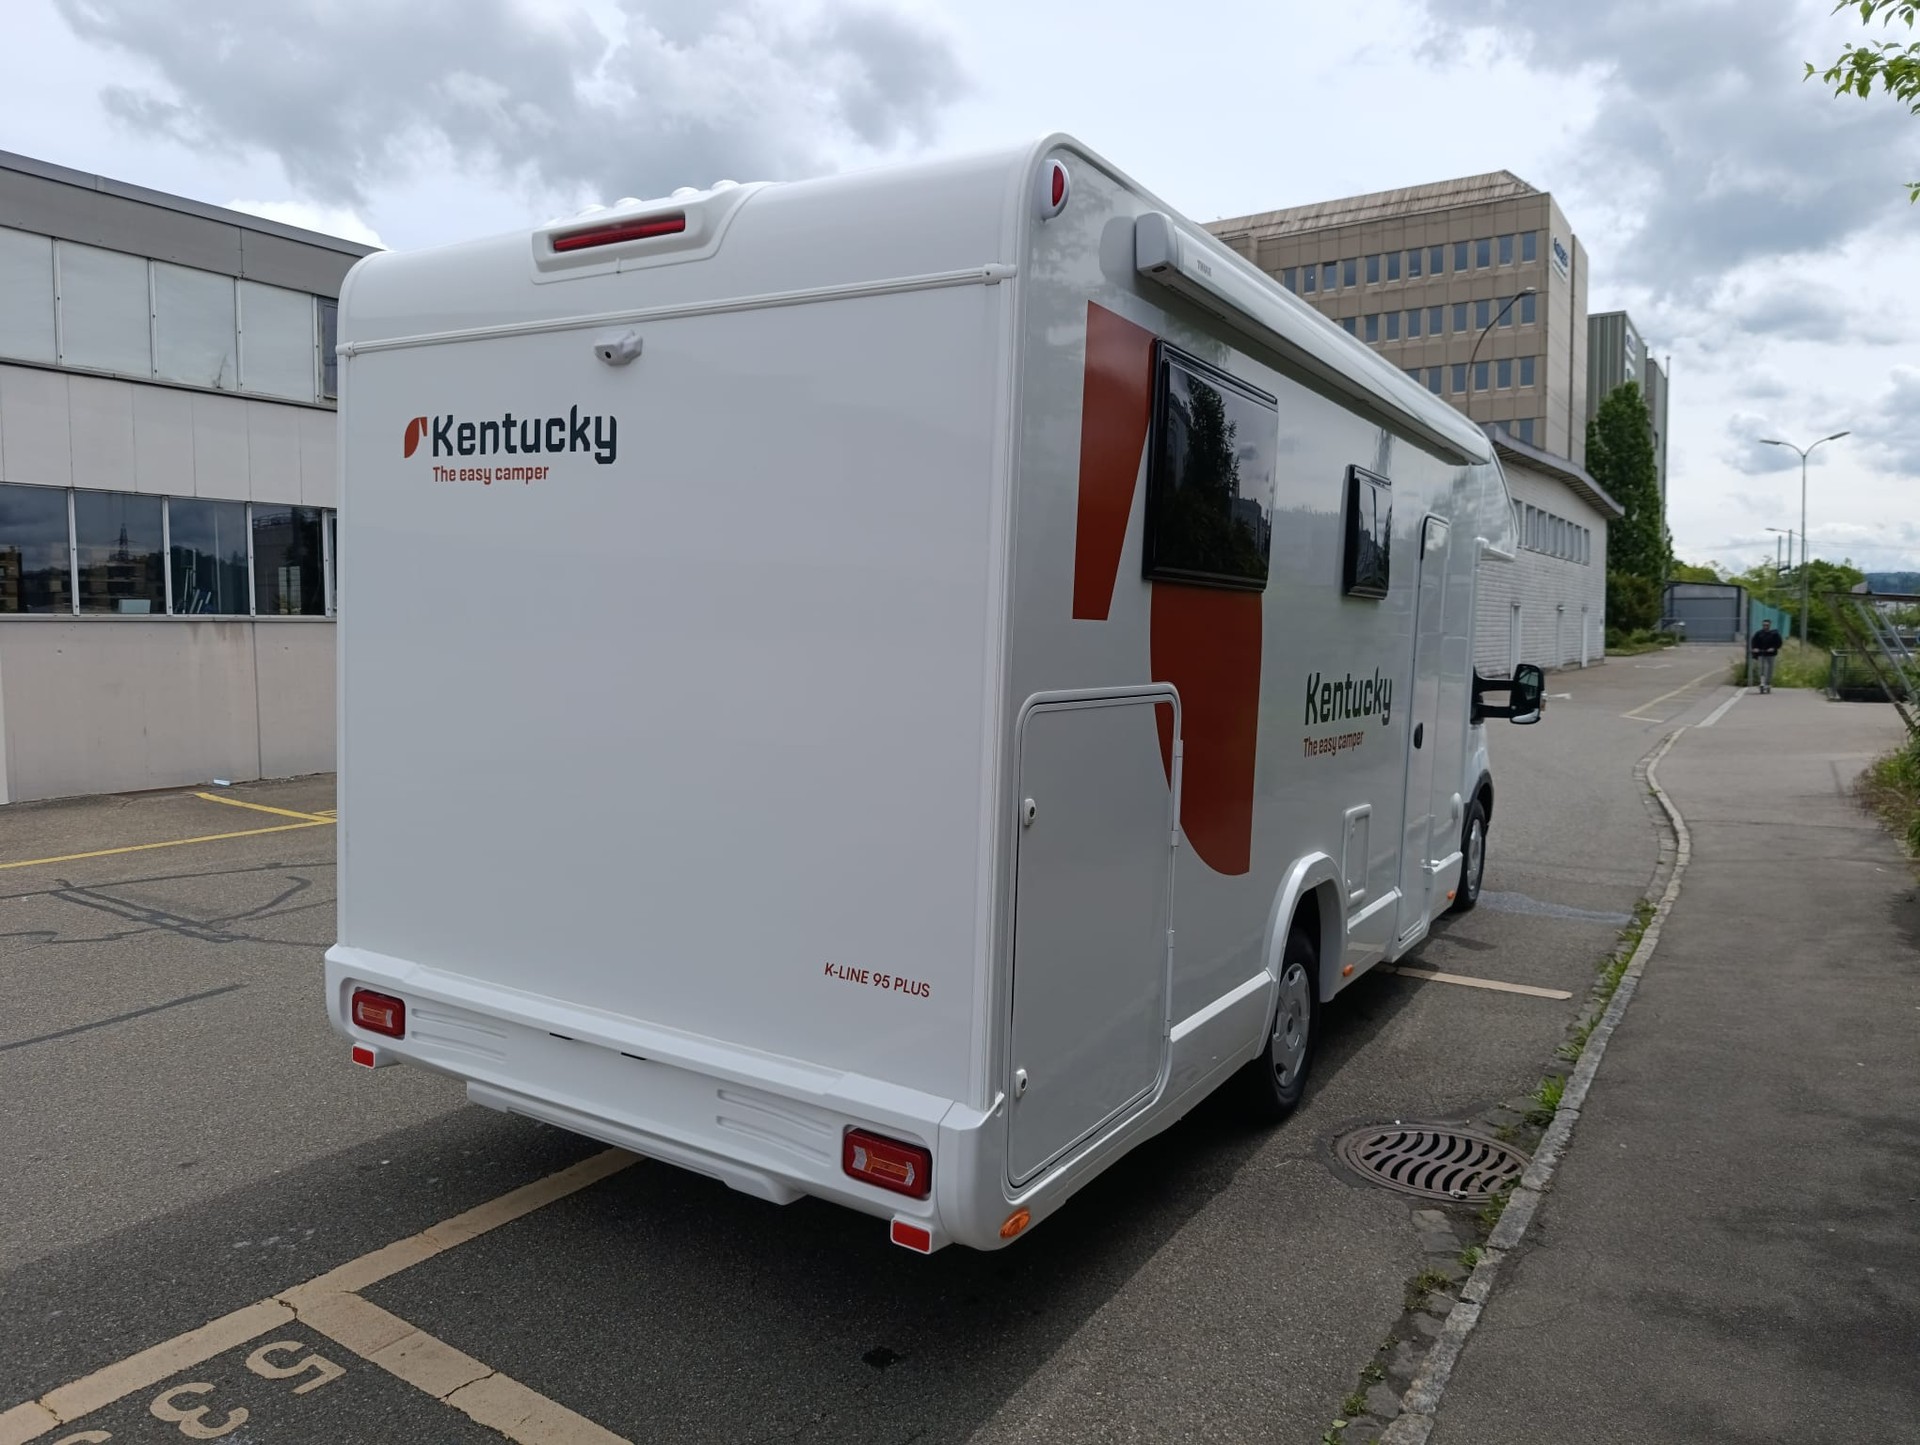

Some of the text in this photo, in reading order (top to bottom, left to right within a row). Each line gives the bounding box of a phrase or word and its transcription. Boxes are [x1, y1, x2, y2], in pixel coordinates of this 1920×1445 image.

[433, 404, 617, 464] Kentucky
[433, 466, 549, 485] The easy camper
[1304, 666, 1392, 726] Kentucky
[1304, 731, 1364, 758] The easy camper
[824, 962, 931, 998] K-LINE 95 PLUS
[52, 1340, 347, 1445] 53
